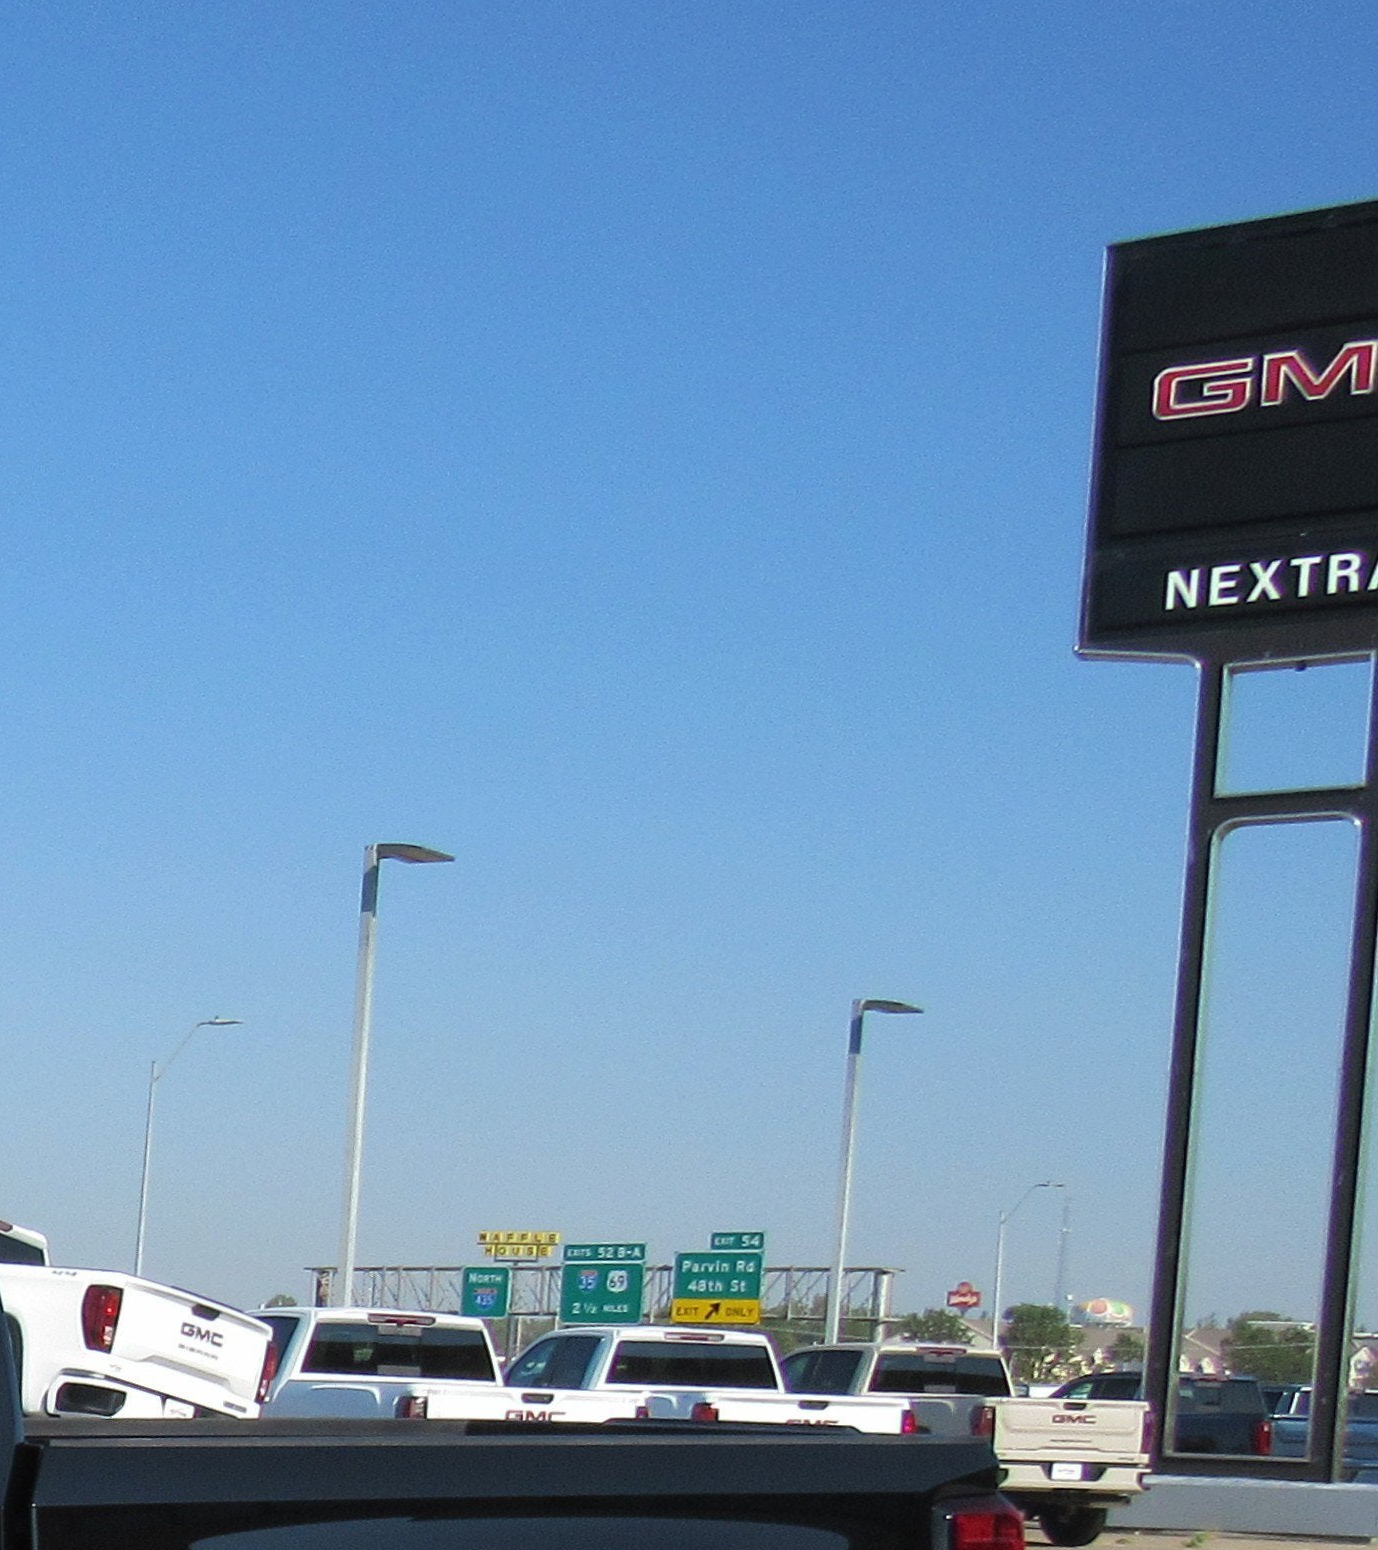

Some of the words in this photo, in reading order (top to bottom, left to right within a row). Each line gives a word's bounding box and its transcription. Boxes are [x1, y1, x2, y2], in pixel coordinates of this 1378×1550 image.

[1164, 552, 1378, 611] NEXTR
[479, 1232, 557, 1242] WAFFLE
[714, 1236, 735, 1246] EXIT
[741, 1235, 760, 1247] 54
[485, 1246, 550, 1256] HOUSE
[681, 1260, 730, 1273] Parvin
[735, 1260, 756, 1273] Rd
[578, 1275, 596, 1290] 35
[609, 1275, 625, 1289] 69
[687, 1279, 723, 1292] 48th
[729, 1279, 747, 1292] St
[475, 1294, 495, 1306] 435
[572, 1302, 581, 1315] 2
[676, 1306, 700, 1316] EXIT
[725, 1307, 755, 1317] ONLY
[180, 1321, 224, 1347] GMC
[1051, 1414, 1097, 1424] GMC
